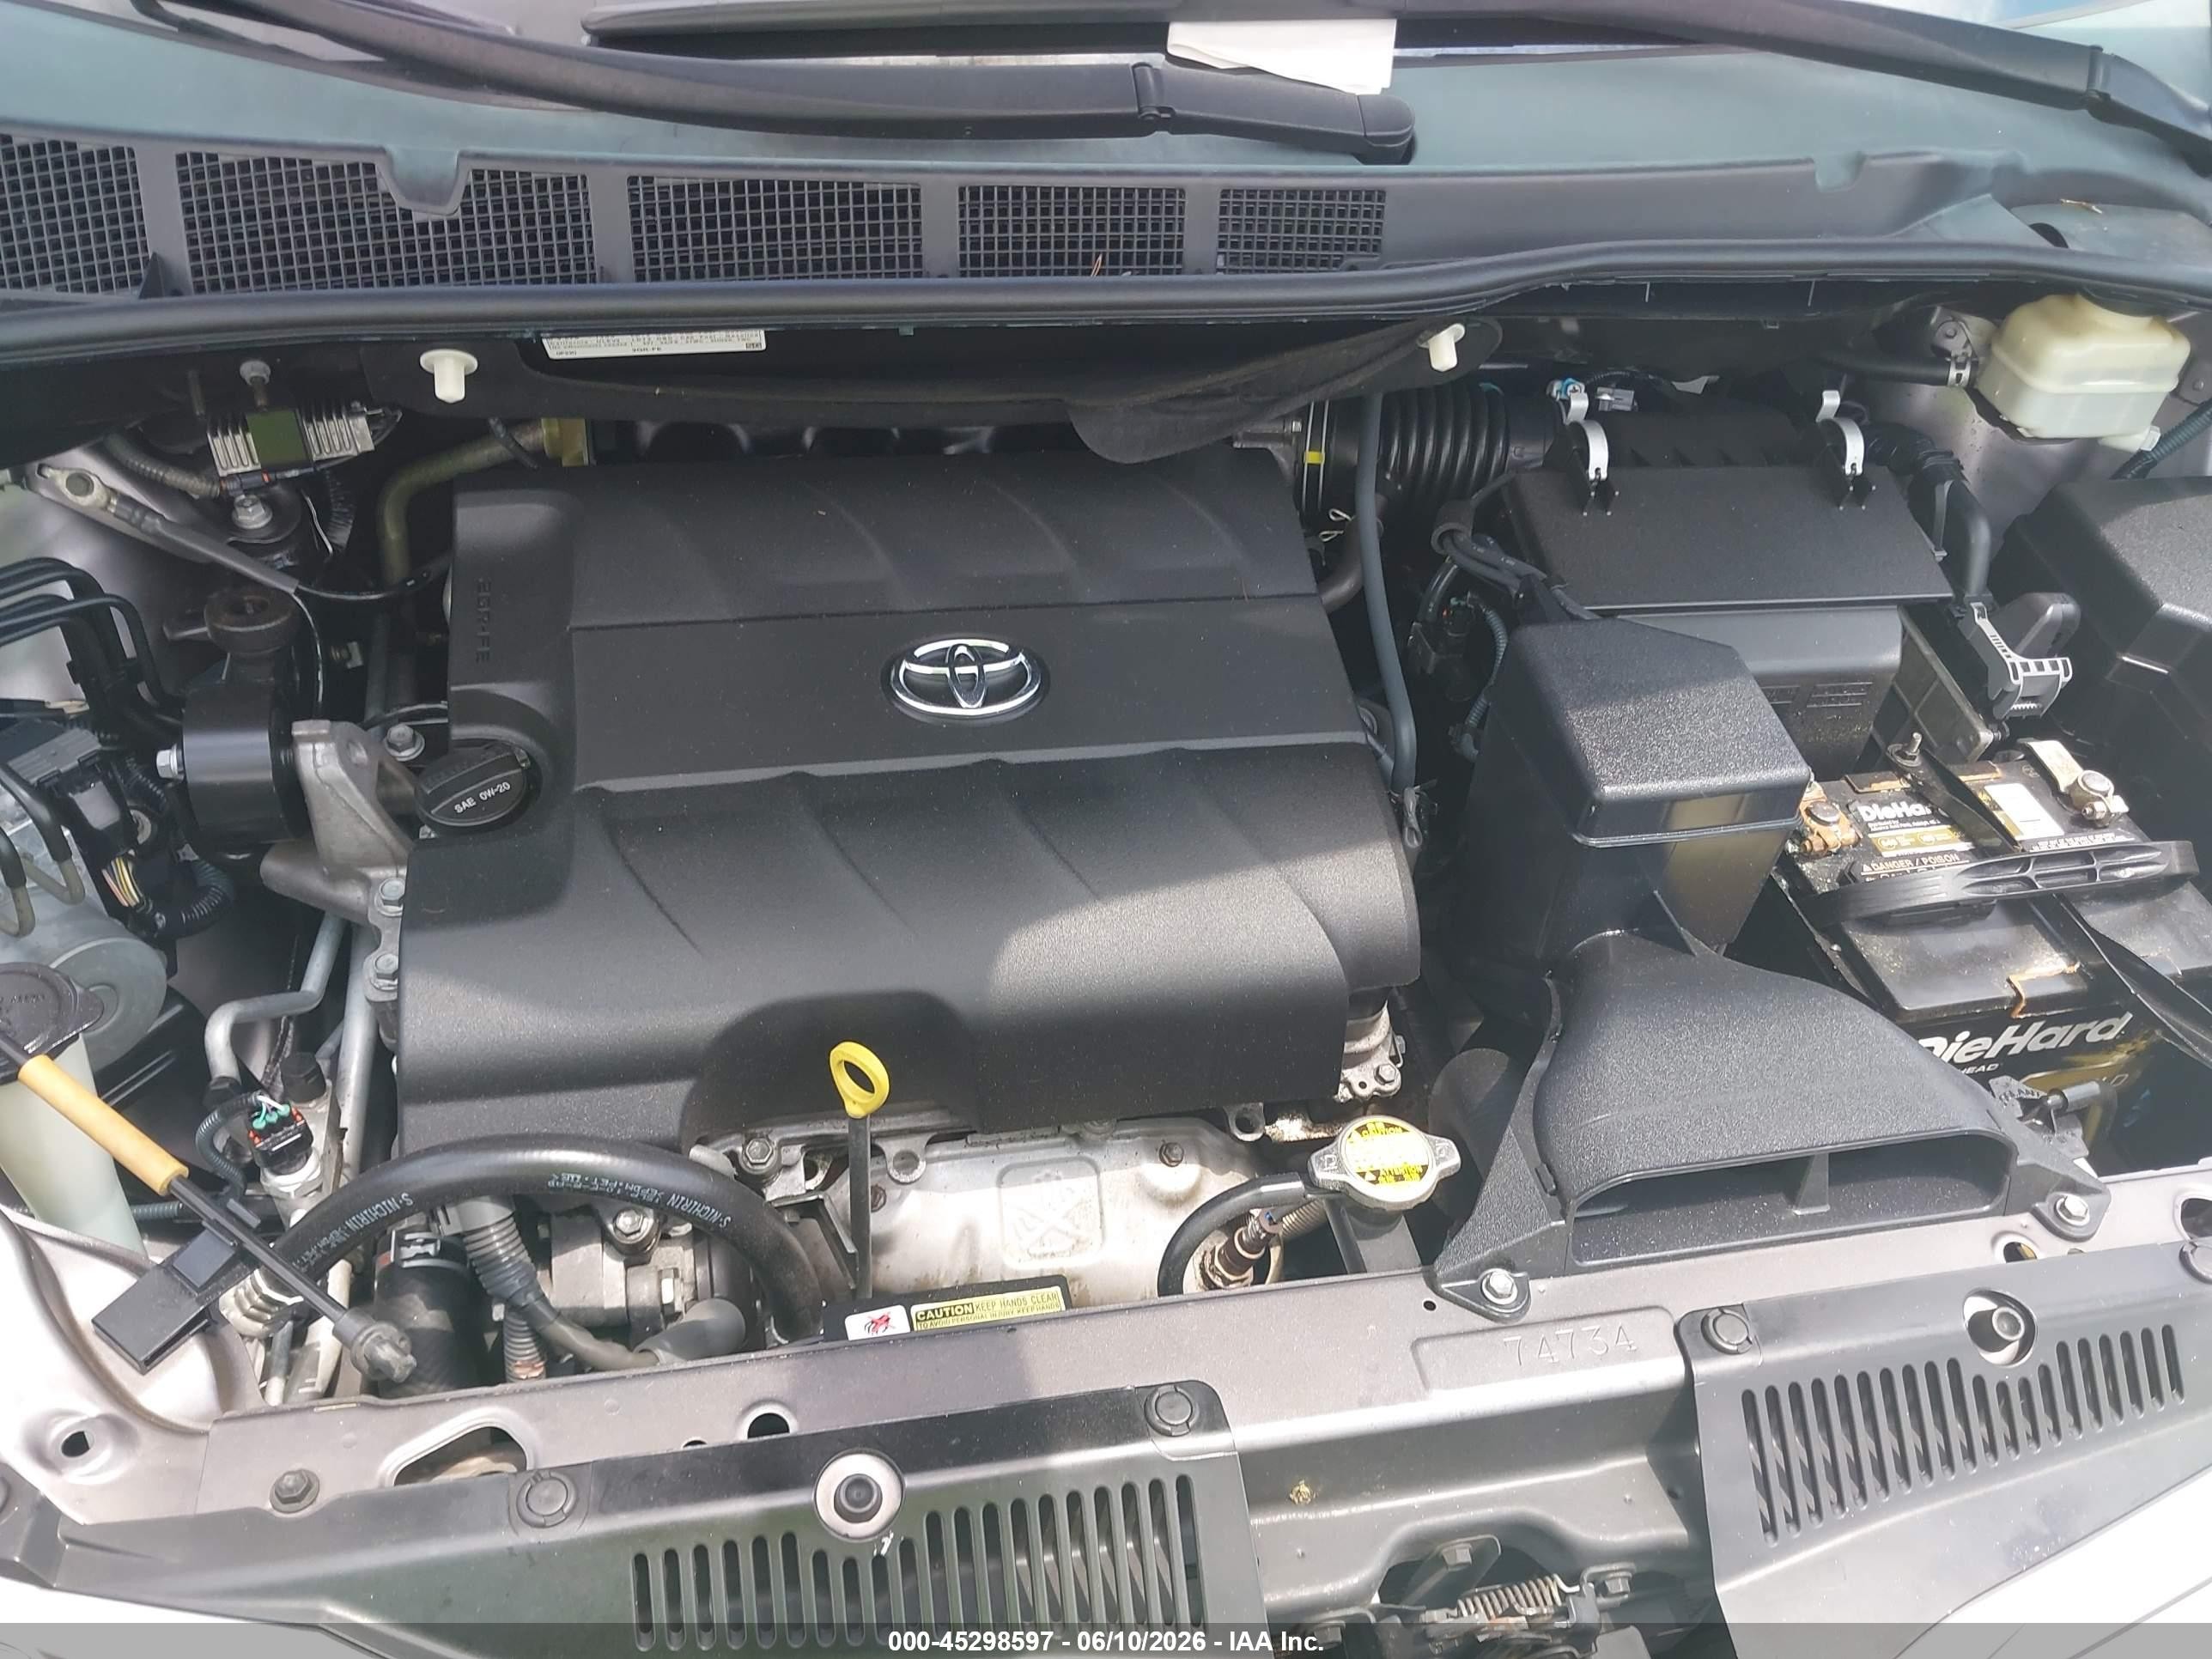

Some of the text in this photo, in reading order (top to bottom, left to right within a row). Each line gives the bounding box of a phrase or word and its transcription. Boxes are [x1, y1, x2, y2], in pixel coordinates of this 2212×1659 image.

[454, 781, 511, 813] SAE 0W-20
[1871, 859, 1914, 872] DANGER
[1921, 853, 1960, 866] POISON
[917, 1291, 1058, 1321] CAUTION KEEP HANDS CLEAR
[1503, 1322, 1638, 1366] 74734
